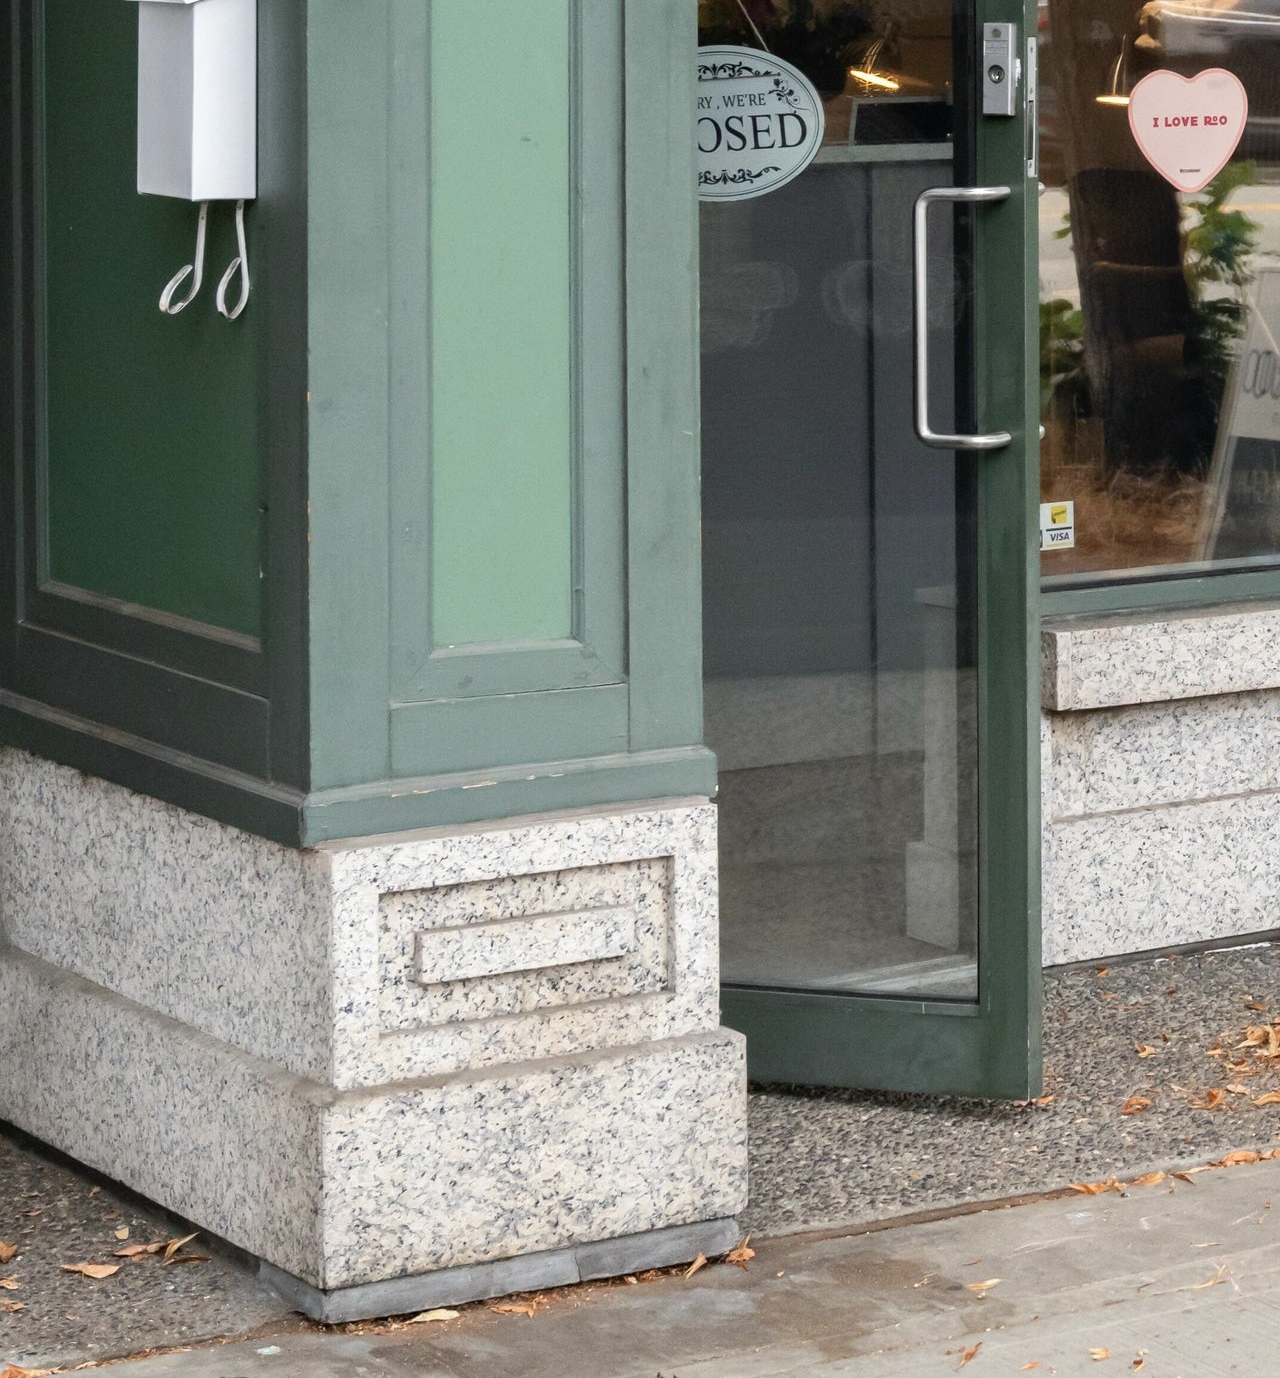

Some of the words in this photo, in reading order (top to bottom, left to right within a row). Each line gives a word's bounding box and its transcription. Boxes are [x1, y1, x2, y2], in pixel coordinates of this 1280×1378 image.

[722, 93, 767, 108] WE'RE
[1153, 118, 1159, 127] I
[1165, 116, 1198, 127] LOVE
[1050, 532, 1070, 542] VISA
